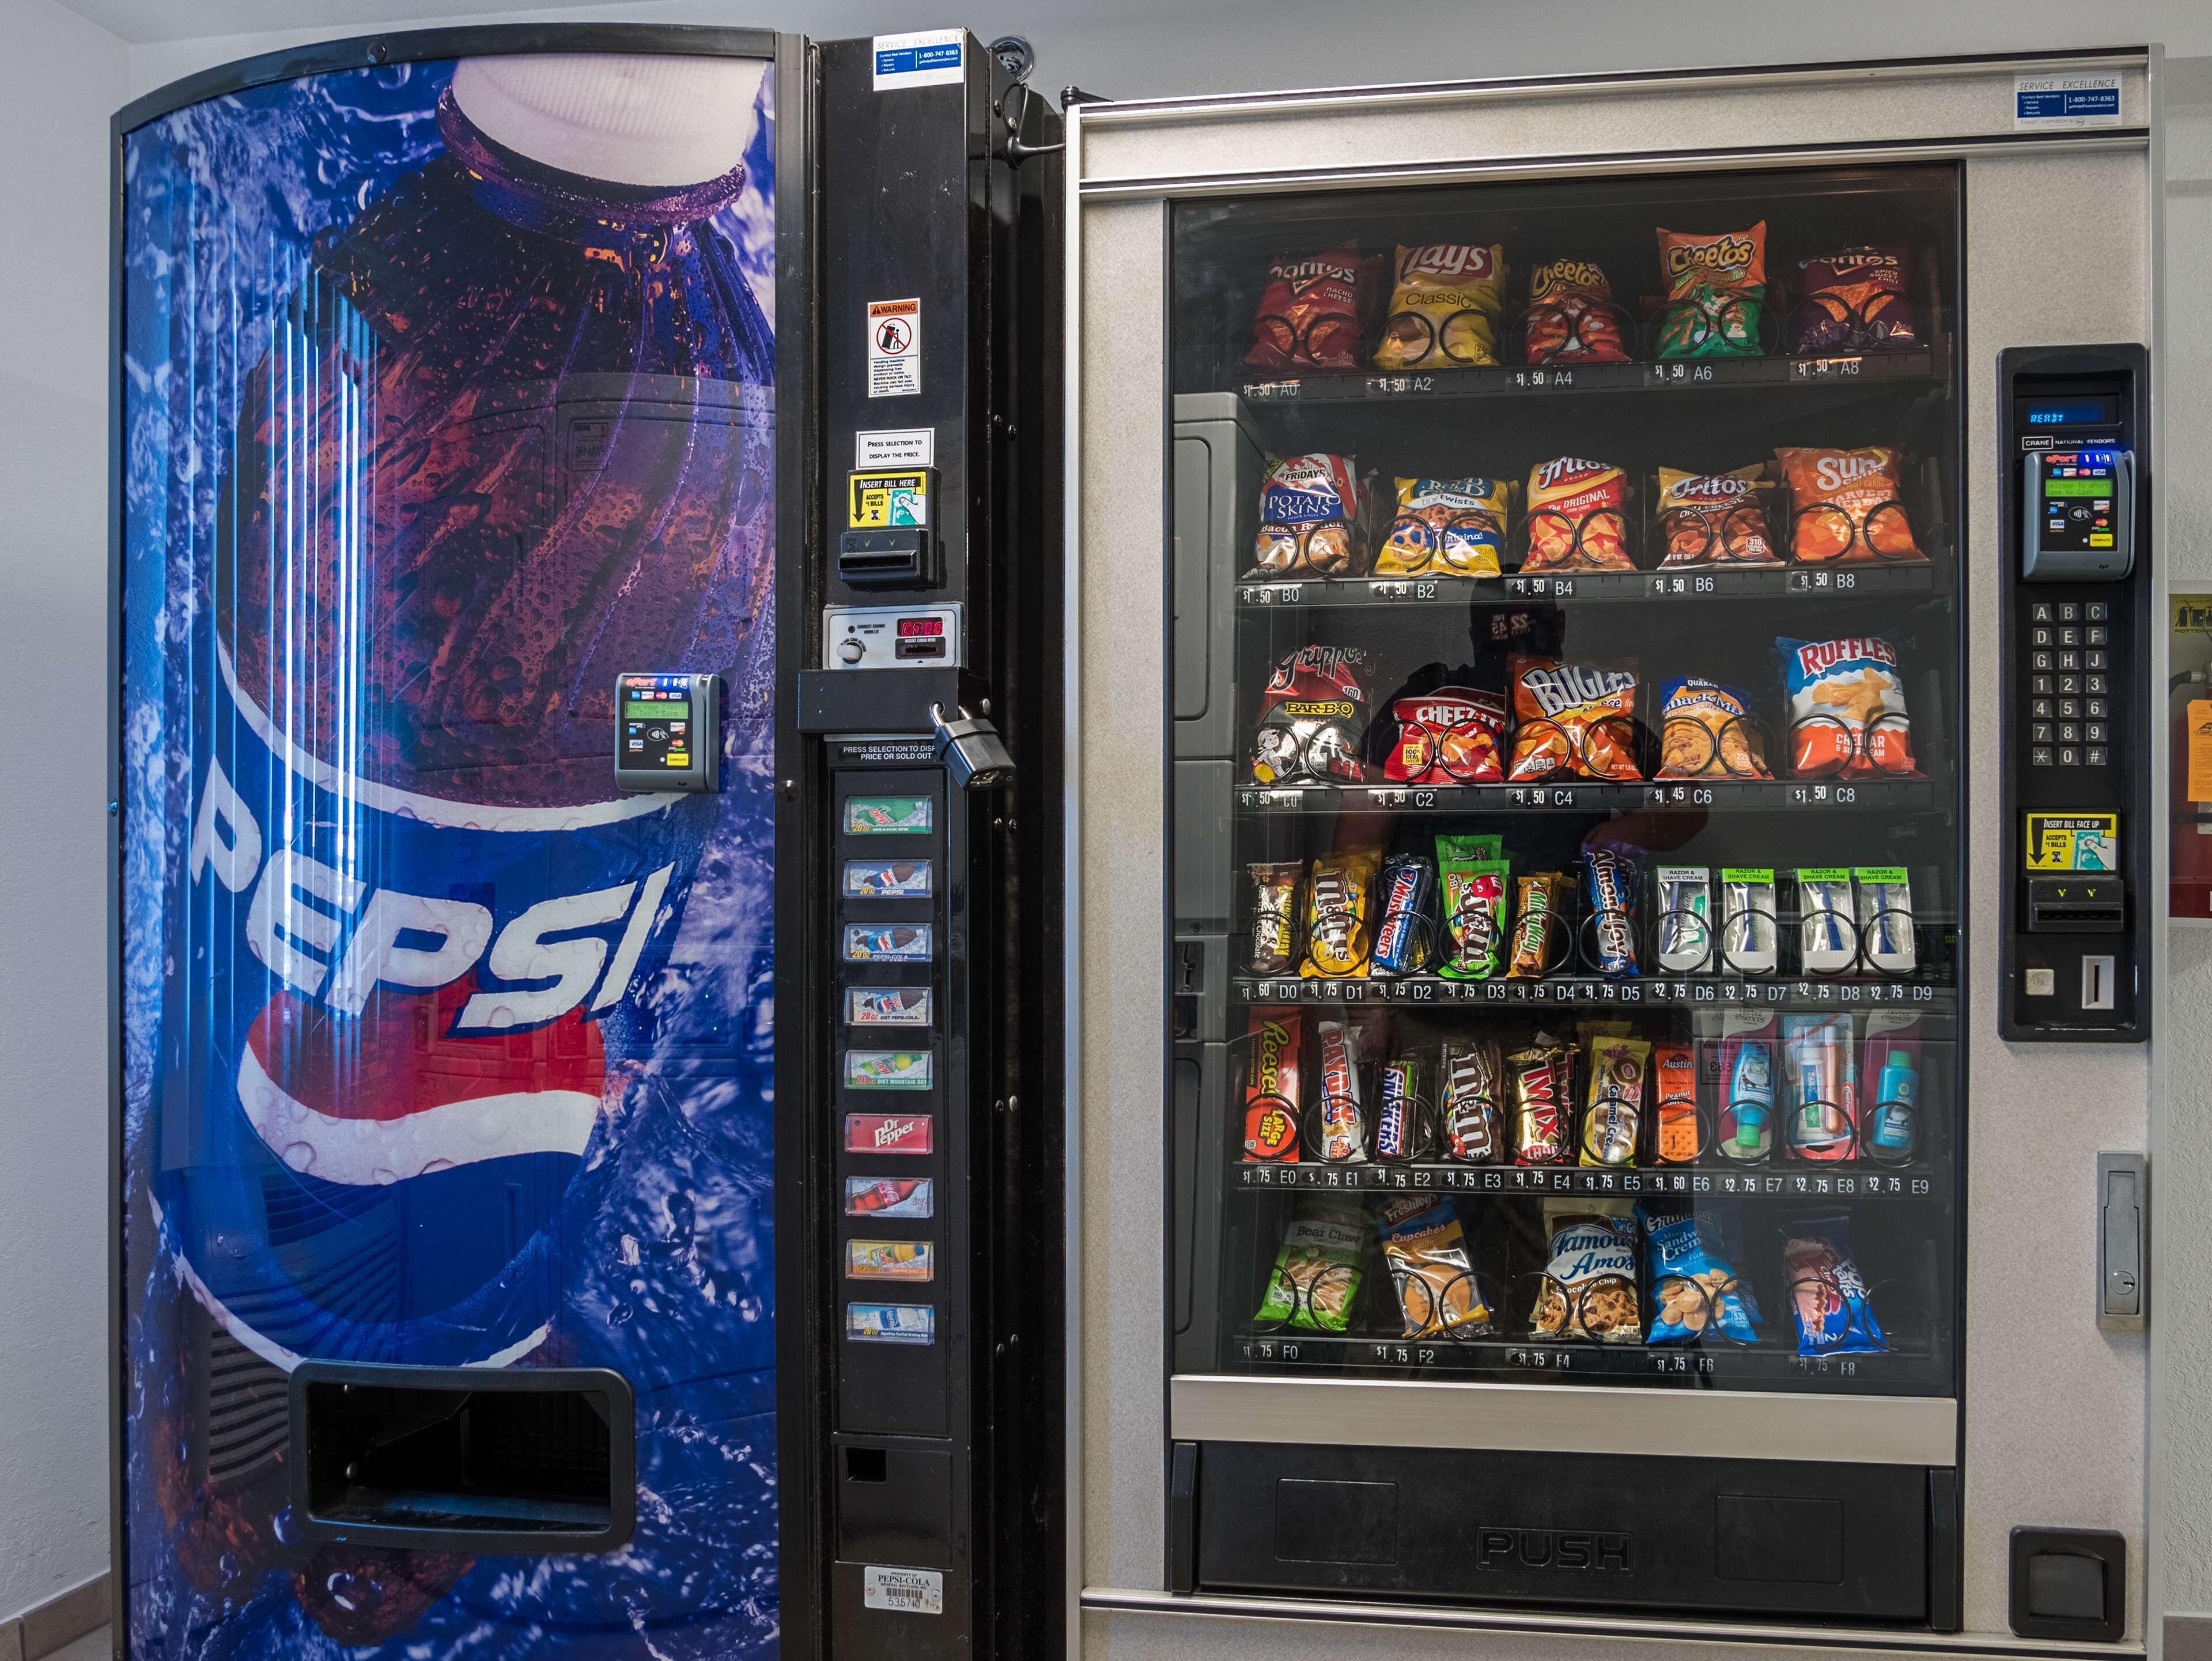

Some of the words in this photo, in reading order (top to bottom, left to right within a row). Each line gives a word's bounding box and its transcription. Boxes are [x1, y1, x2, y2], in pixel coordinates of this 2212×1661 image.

[2019, 82, 2055, 91] SERVICE
[2062, 80, 2116, 89] EXCELLENCE
[1404, 245, 1487, 276] Lay's
[1670, 237, 1754, 275] Cheetos
[1533, 261, 1604, 298] Cheetos
[1323, 292, 1352, 304] CHEESE
[1326, 287, 1353, 298] NACHO
[1406, 293, 1472, 309] Classic
[881, 304, 916, 314] WARNING
[1693, 366, 1712, 380] A6
[1840, 361, 1859, 375] A8
[1413, 377, 1432, 392] A2
[1554, 371, 1572, 385] A4
[1280, 382, 1297, 397] A0
[2030, 414, 2064, 423] READY
[2025, 440, 2050, 448] CRANE
[1538, 456, 1614, 490] Fritos
[1816, 457, 1880, 492] Sun
[860, 479, 883, 489] INSERT
[884, 479, 897, 488] BILL
[899, 479, 916, 487] HERE
[1671, 478, 1748, 500] Fritos
[1269, 494, 1341, 510] POTATO
[1421, 496, 1440, 505] tiny
[1440, 494, 1475, 506] twists
[1563, 489, 1610, 509] ORIGINAL
[1276, 504, 1330, 520] SKINS
[1749, 538, 1763, 546] 310
[1696, 577, 1714, 592] B6
[1836, 573, 1855, 588] B8
[1282, 588, 1299, 603] B0
[1417, 584, 1434, 599] B2
[1555, 581, 1573, 596] B4
[2036, 607, 2047, 620] A
[2064, 606, 2073, 619] B
[2091, 606, 2100, 619] C
[2037, 630, 2046, 644] D
[2064, 631, 2073, 644] E
[2091, 630, 2099, 643] F
[1798, 638, 1897, 679] RUFFLES
[2037, 654, 2046, 668] G
[2064, 654, 2073, 667] H
[2091, 654, 2099, 667] J
[2038, 678, 2044, 691] 1
[2064, 678, 2073, 691] 2
[2090, 678, 2100, 691] 3
[1285, 702, 1354, 718] BAR-B-Q
[2037, 702, 2045, 715] 4
[2064, 702, 2073, 715] 5
[2090, 702, 2100, 715] 6
[2037, 727, 2046, 739] 7
[2064, 726, 2073, 739] 8
[2091, 726, 2100, 739] 9
[861, 753, 883, 761] PRICE
[895, 752, 916, 760] SOLD
[917, 752, 932, 760] OUT
[2064, 750, 2072, 763] 0
[1416, 792, 1434, 807] C2
[1555, 790, 1573, 805] C4
[1693, 789, 1712, 804] C6
[1836, 788, 1855, 803] C8
[2043, 818, 2063, 828] INSERT
[2064, 820, 2075, 828] BILL
[2077, 820, 2090, 828] FACE
[2092, 820, 2100, 828] UP
[191, 754, 675, 1028] PEPSI
[1280, 984, 1297, 999] D0
[1347, 985, 1362, 1000] D1
[1413, 985, 1431, 1000] D2
[1487, 985, 1505, 1000] D3
[1557, 985, 1575, 1000] D4
[1621, 985, 1640, 1000] D5
[1695, 986, 1714, 1001] D6
[1768, 986, 1786, 1001] D7
[1841, 986, 1860, 1001] D8
[1913, 986, 1932, 1001] D9
[1662, 1059, 1693, 1069] Austin
[1321, 1030, 1356, 1125] PAYDAY
[1521, 1058, 1560, 1141] TWIX
[884, 1119, 899, 1133] Dr
[1261, 1116, 1275, 1138] SIZE
[1268, 1107, 1287, 1147] LARGE
[875, 1122, 915, 1148] Pepper
[1280, 1170, 1296, 1185] E0
[1346, 1171, 1358, 1186] E1
[1415, 1172, 1431, 1186] E2
[1484, 1173, 1501, 1188] E3
[1555, 1175, 1571, 1190] E4
[1624, 1176, 1641, 1191] E5
[1693, 1177, 1710, 1191] E6
[1766, 1178, 1783, 1193] E7
[1837, 1178, 1855, 1193] E8
[1911, 1179, 1929, 1194] E9
[1384, 1193, 1439, 1222] Freshley's
[1296, 1225, 1326, 1239] Bear
[1328, 1229, 1362, 1243] Claw
[1392, 1224, 1447, 1244] Cupcakes
[1551, 1232, 1633, 1257] Famous
[1598, 1277, 1617, 1286] Chip
[1734, 1312, 1746, 1321] 530
[1283, 1345, 1298, 1359] F0
[1419, 1349, 1435, 1364] F2
[1556, 1354, 1571, 1368] F4
[1699, 1358, 1714, 1372] F6
[1841, 1361, 1855, 1376] F8
[1479, 1529, 1632, 1571] PUSH
[878, 1574, 930, 1587] PEPSI-COLA
